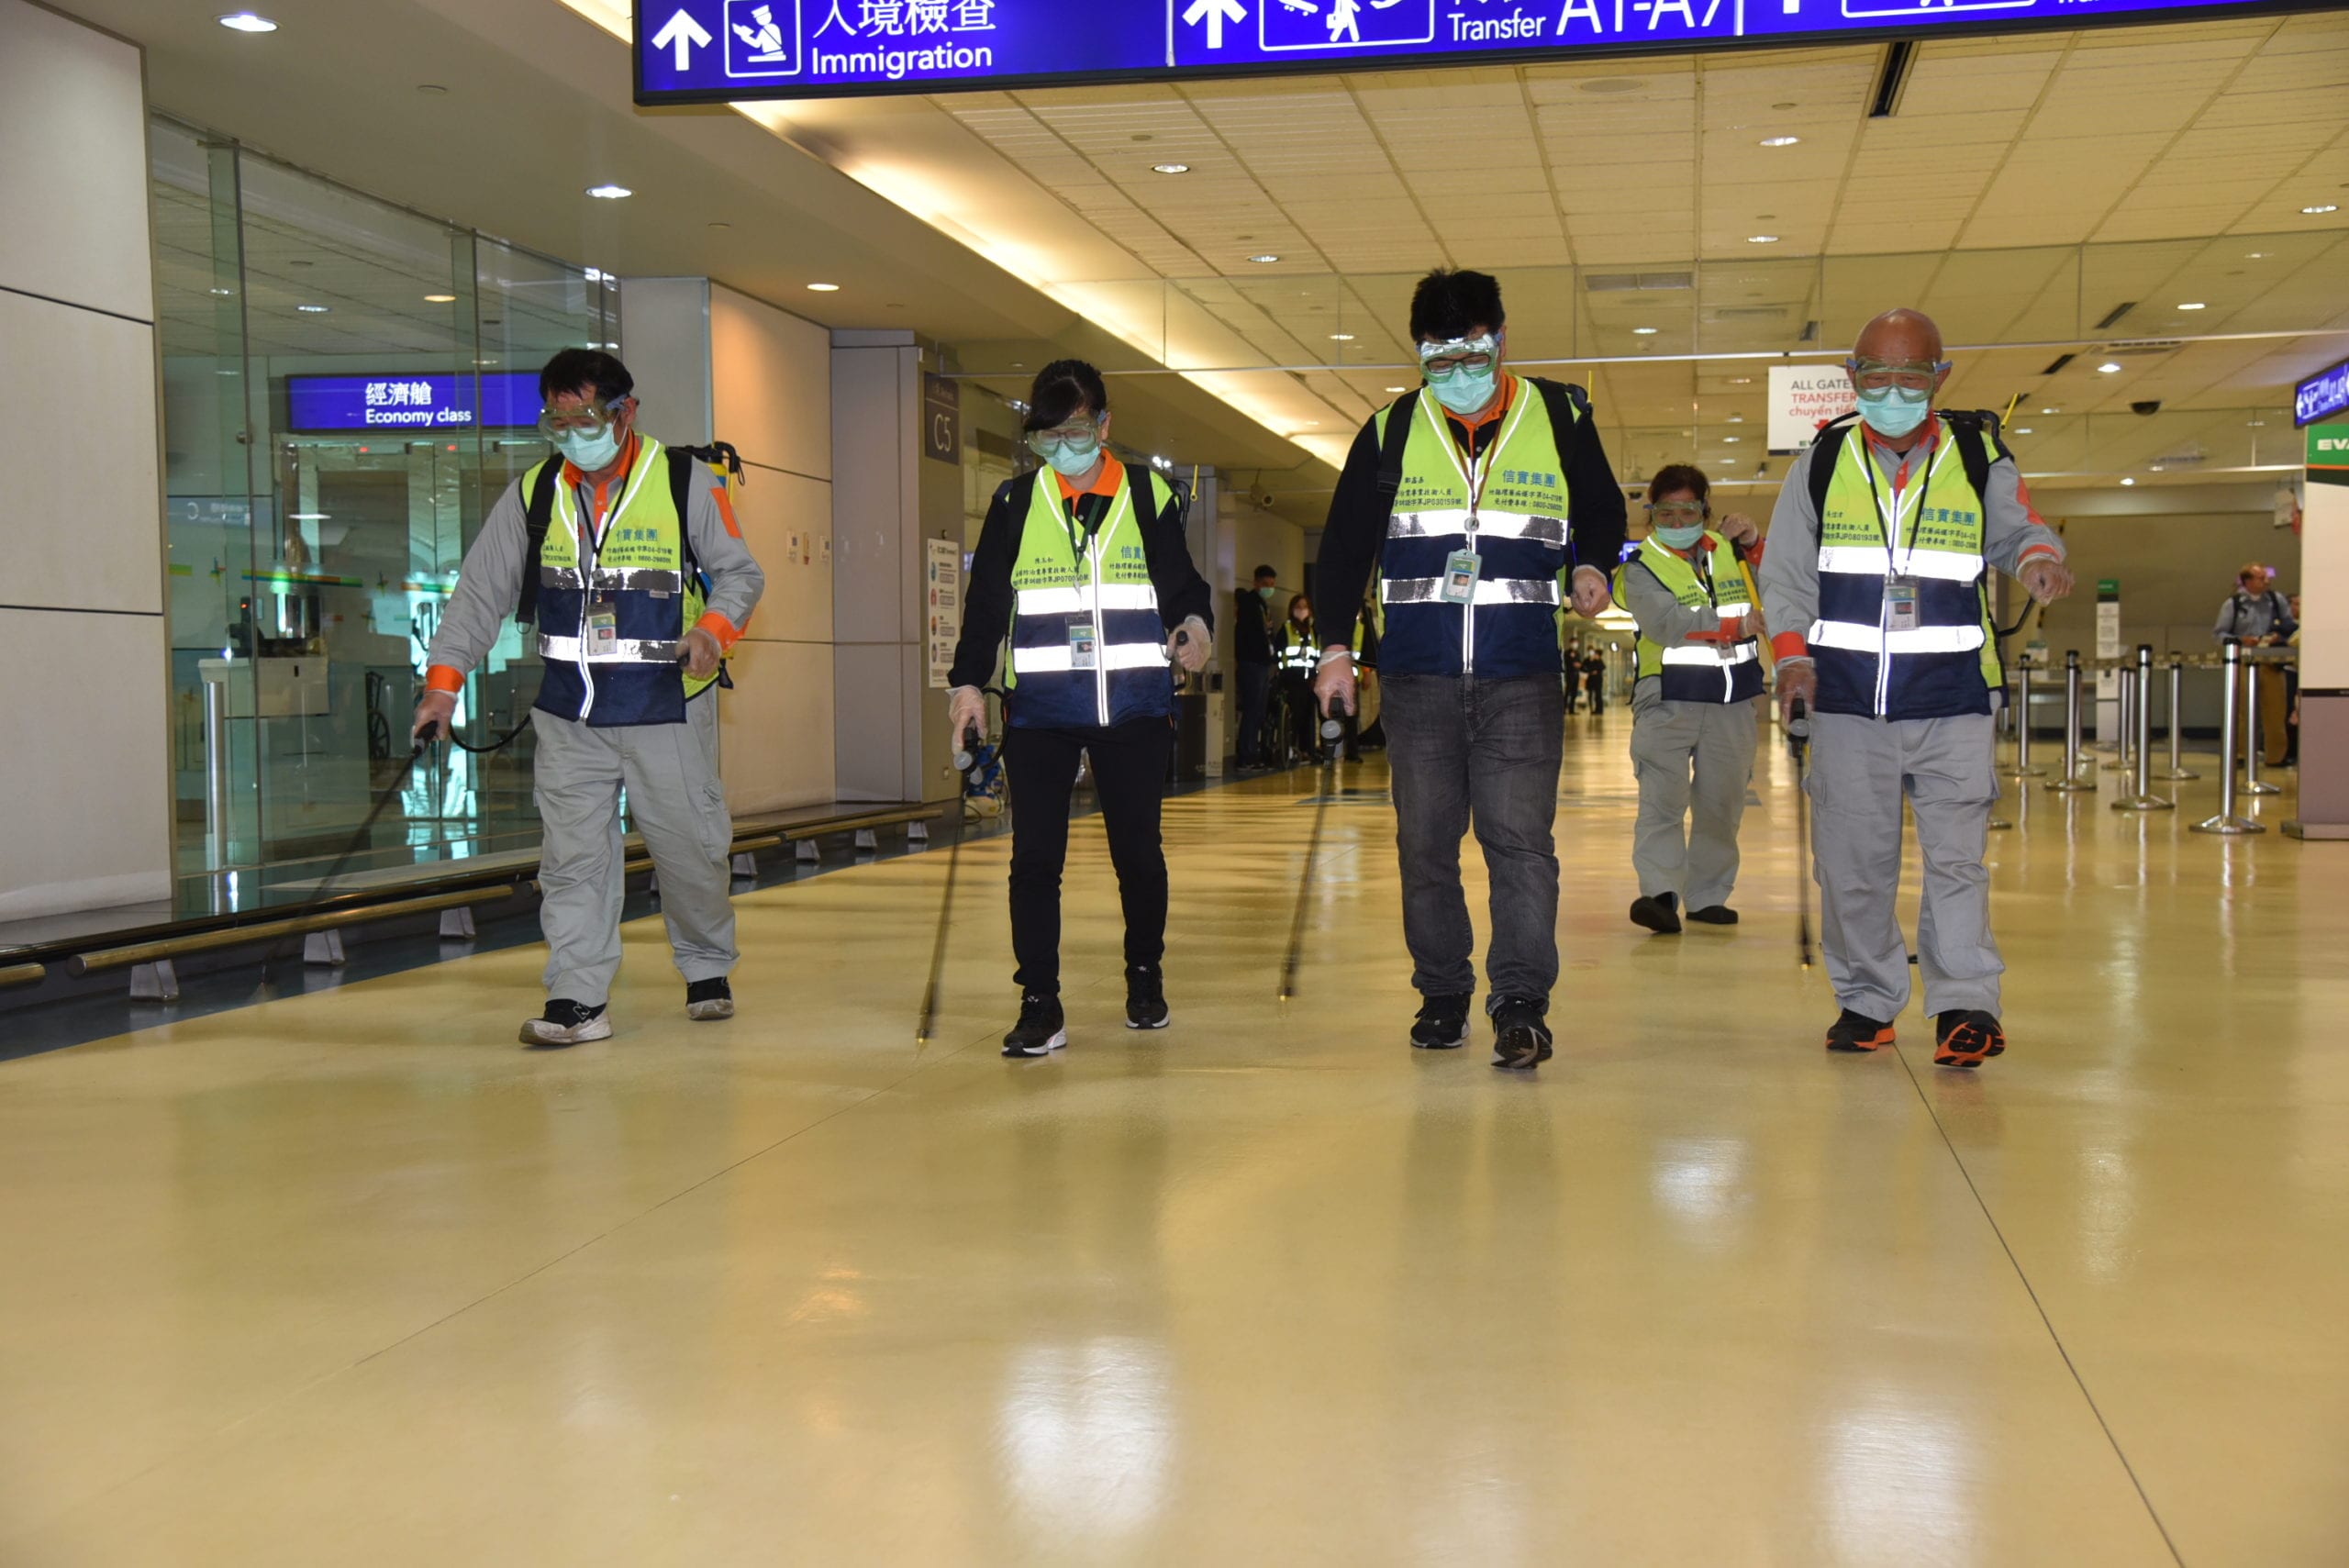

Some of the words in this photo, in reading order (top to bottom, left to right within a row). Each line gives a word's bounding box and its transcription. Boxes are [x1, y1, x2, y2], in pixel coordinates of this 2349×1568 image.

[813, 0, 996, 39] 入境檢查
[1447, 8, 1546, 41] Transfer
[811, 42, 993, 79] Immigration
[365, 382, 432, 406] 經濟艙
[1791, 380, 1813, 391] ALL
[1817, 379, 1854, 390] GATE
[1791, 392, 1857, 404] TRANSFER
[366, 408, 434, 426] Economy
[437, 406, 472, 422] class
[934, 413, 952, 453] C5
